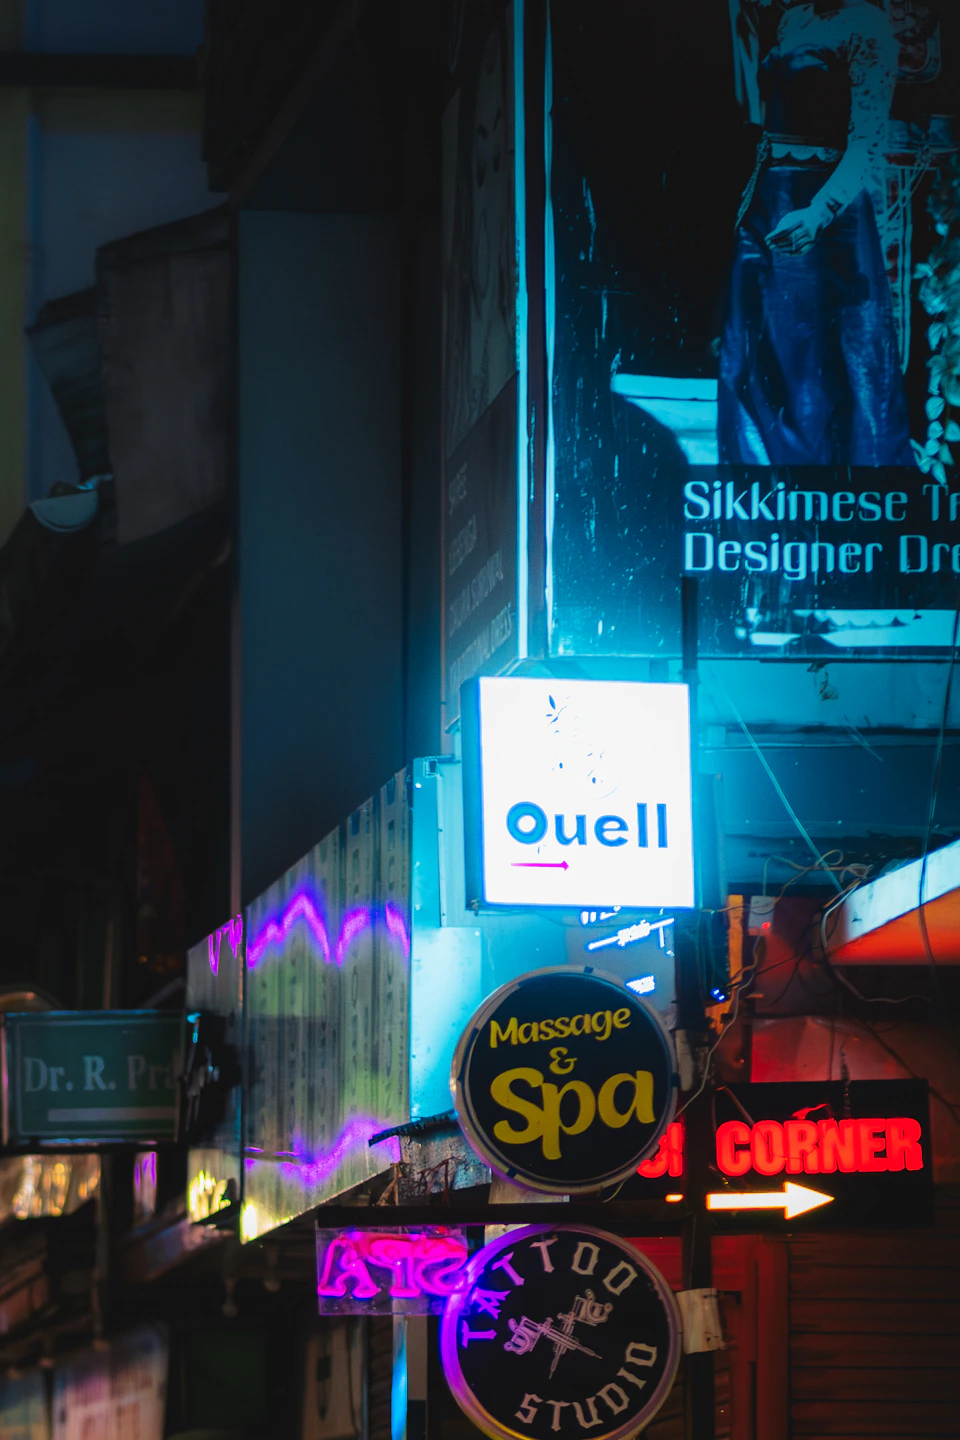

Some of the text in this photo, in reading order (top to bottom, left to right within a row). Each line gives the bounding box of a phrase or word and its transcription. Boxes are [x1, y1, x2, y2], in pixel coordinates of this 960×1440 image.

[684, 480, 908, 521] Sikkimese
[684, 532, 883, 581] Designer
[490, 1008, 631, 1048] Massage
[24, 1057, 73, 1092] Dr.
[83, 1055, 116, 1090] R.
[549, 1047, 578, 1075] &
[490, 1067, 656, 1160] Spa
[716, 1118, 924, 1177] CORNER
[462, 1236, 638, 1348] TATTOO
[515, 1341, 657, 1432] STUDIO
